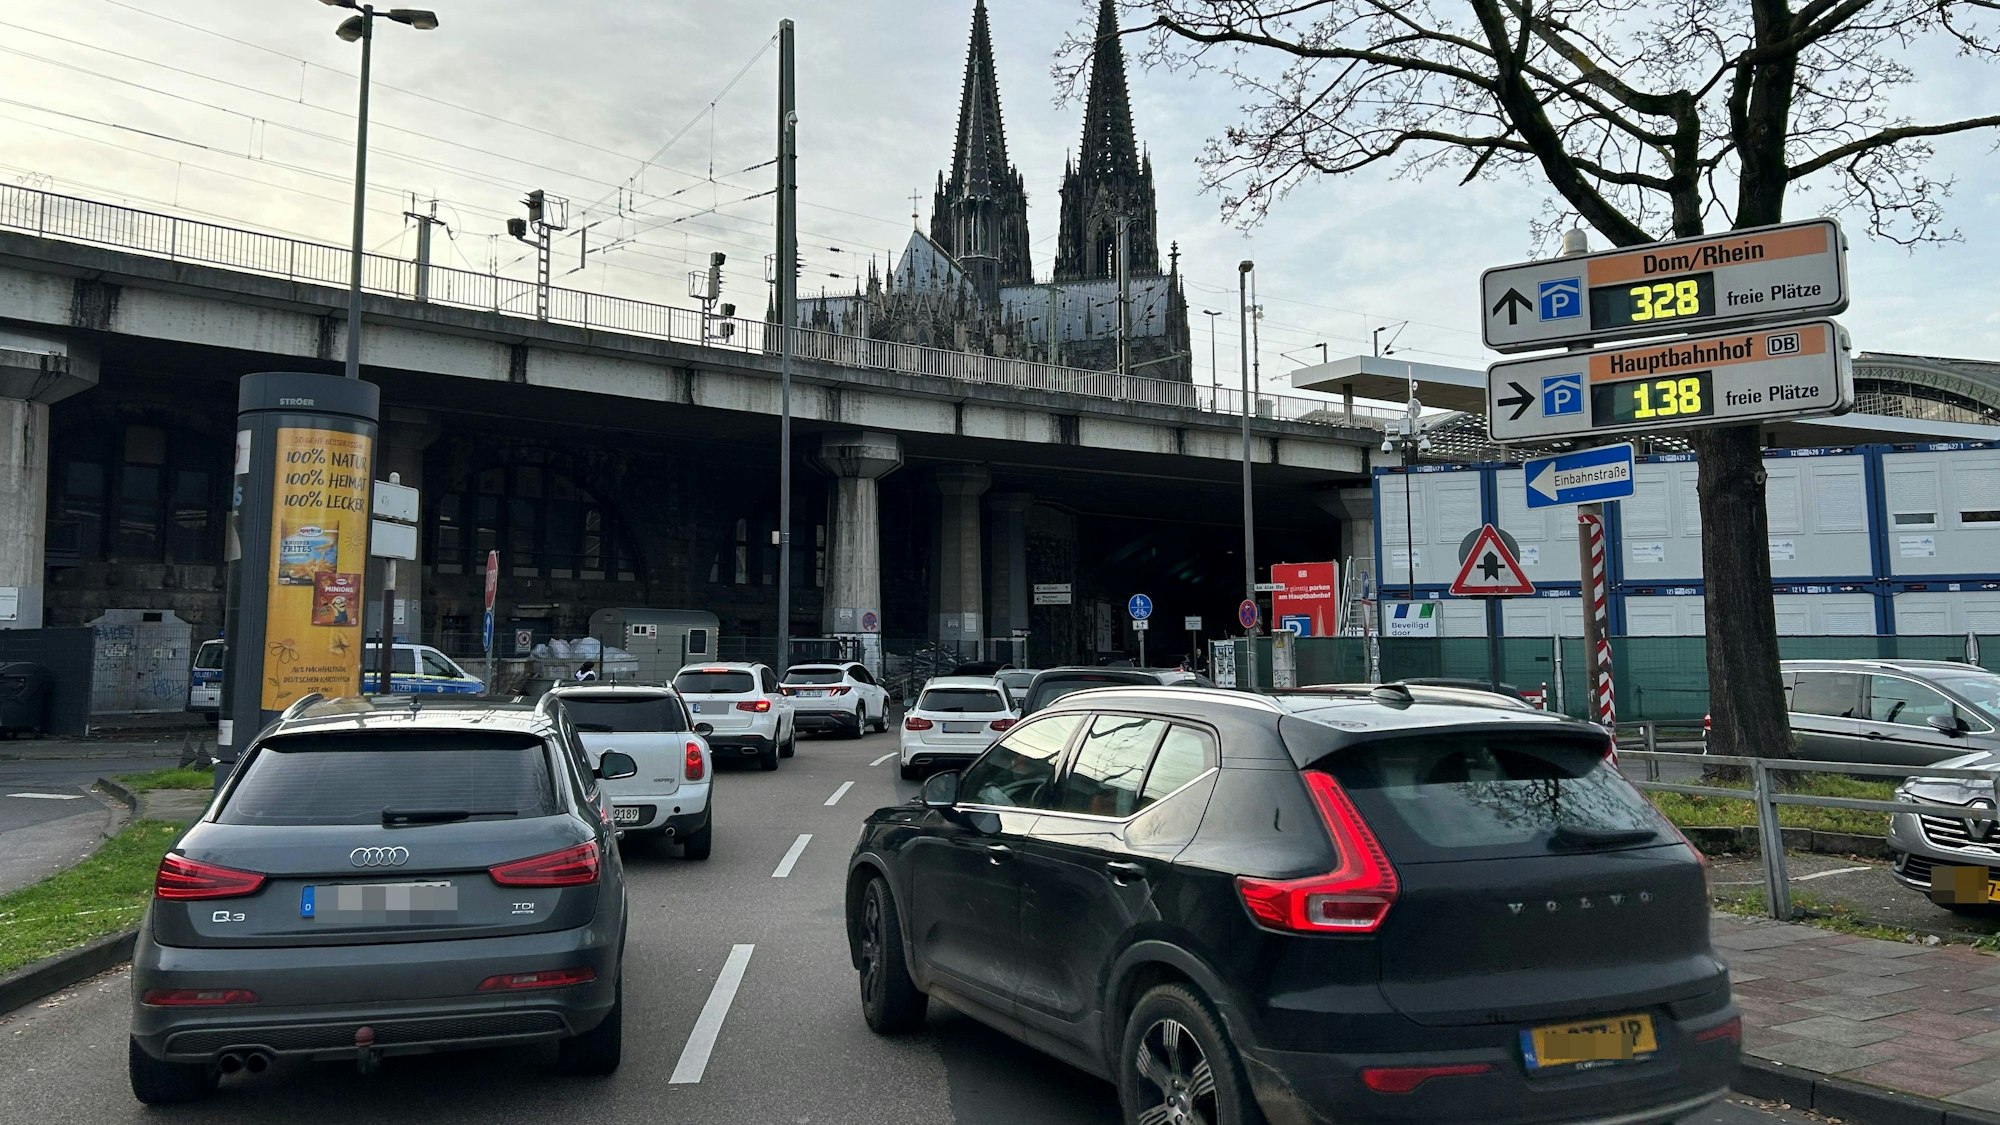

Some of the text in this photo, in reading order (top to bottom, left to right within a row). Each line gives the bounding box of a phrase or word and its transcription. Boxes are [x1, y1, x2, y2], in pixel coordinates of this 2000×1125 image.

[1643, 241, 1764, 275] Dom/Rhein
[1551, 294, 1570, 318] P
[1630, 279, 1699, 322] 328
[1727, 283, 1822, 307] freie Plätze
[1610, 337, 1753, 374] Hauptbahnhof
[1771, 337, 1795, 351] DB
[280, 398, 314, 406] STRÖER
[1553, 389, 1571, 414] P
[1633, 377, 1701, 420] 138
[1726, 384, 1819, 407] freie Plätze
[286, 448, 367, 472] 100% NATUR
[285, 469, 367, 492] 100% HEIMAT
[1554, 466, 1627, 488] Einbahnstraße
[284, 491, 365, 514] 100% LECKER
[282, 545, 312, 553] FRITES
[325, 585, 354, 593] MINIONS
[1289, 592, 1331, 600] Hauptbahnhof
[1309, 584, 1331, 592] parken
[1391, 622, 1429, 630] Beveiligd
[512, 902, 535, 910] TDI
[1508, 891, 1653, 914] VOLVO
[212, 910, 246, 923] Q3
